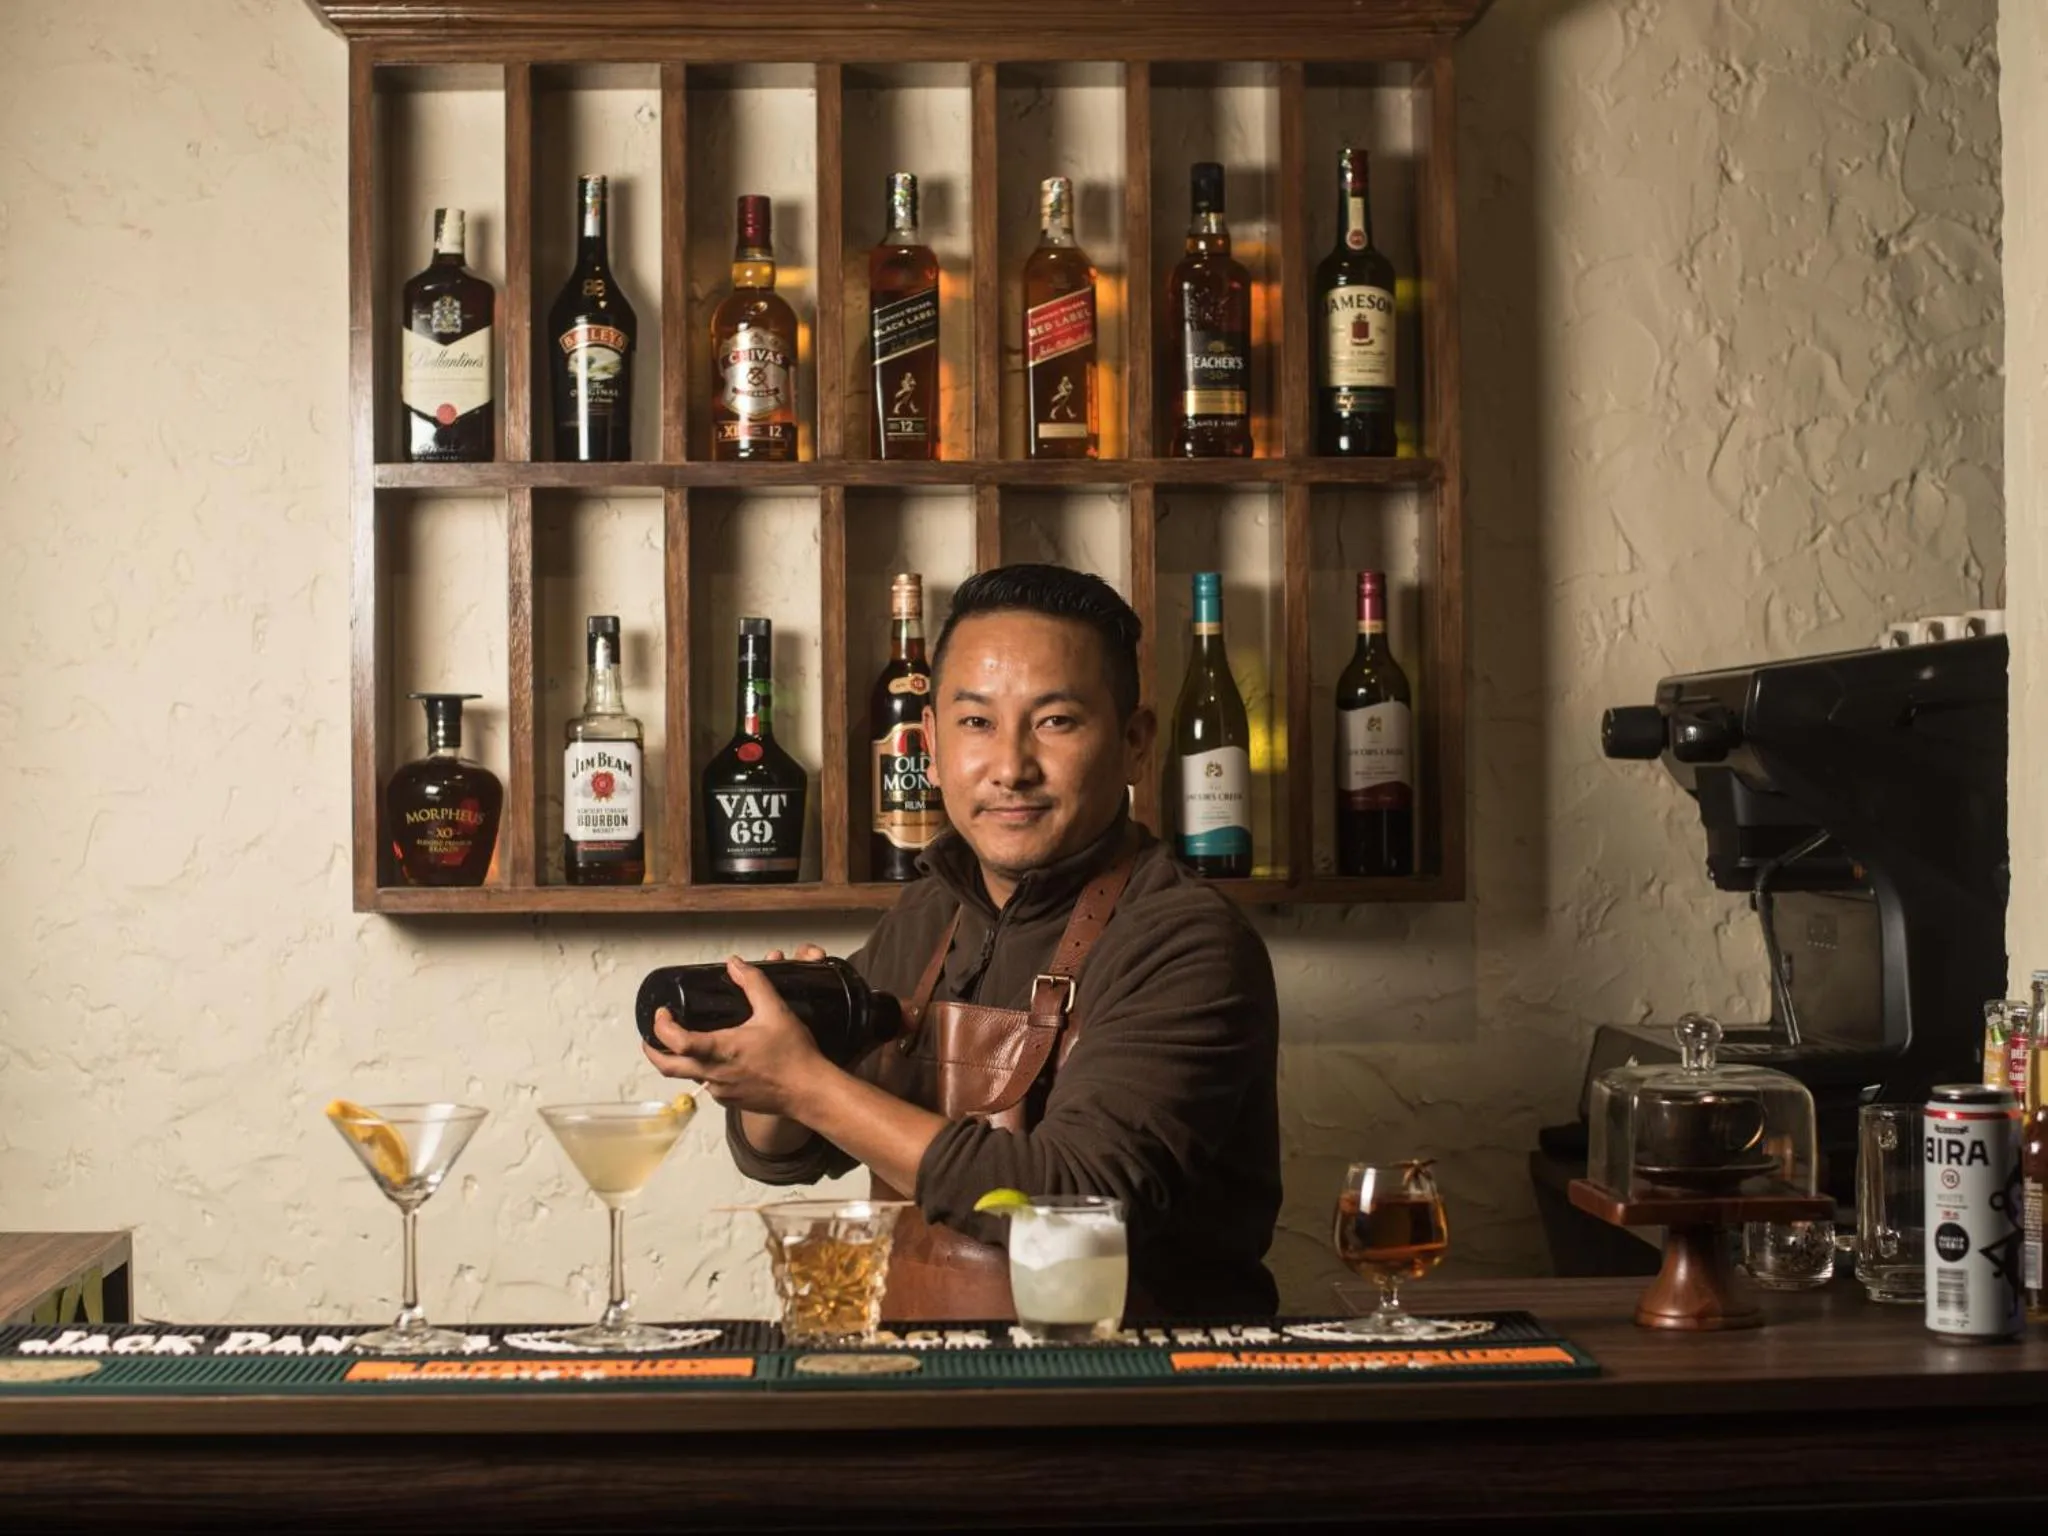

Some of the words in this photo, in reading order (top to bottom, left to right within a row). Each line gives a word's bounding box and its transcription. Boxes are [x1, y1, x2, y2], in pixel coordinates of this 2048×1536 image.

[1055, 309, 1092, 327] LABEL
[900, 420, 914, 433] 12
[572, 756, 595, 779] JIM
[597, 751, 633, 778] BEAM
[895, 755, 932, 774] OLD
[884, 773, 938, 790] MON
[715, 793, 788, 819] VAT
[904, 800, 926, 810] RUM
[405, 807, 486, 826] MORPHEUS
[576, 814, 629, 828] BOURBON
[435, 827, 454, 839] XO
[729, 819, 773, 844] 69
[1925, 1138, 1990, 1167] BIRA
